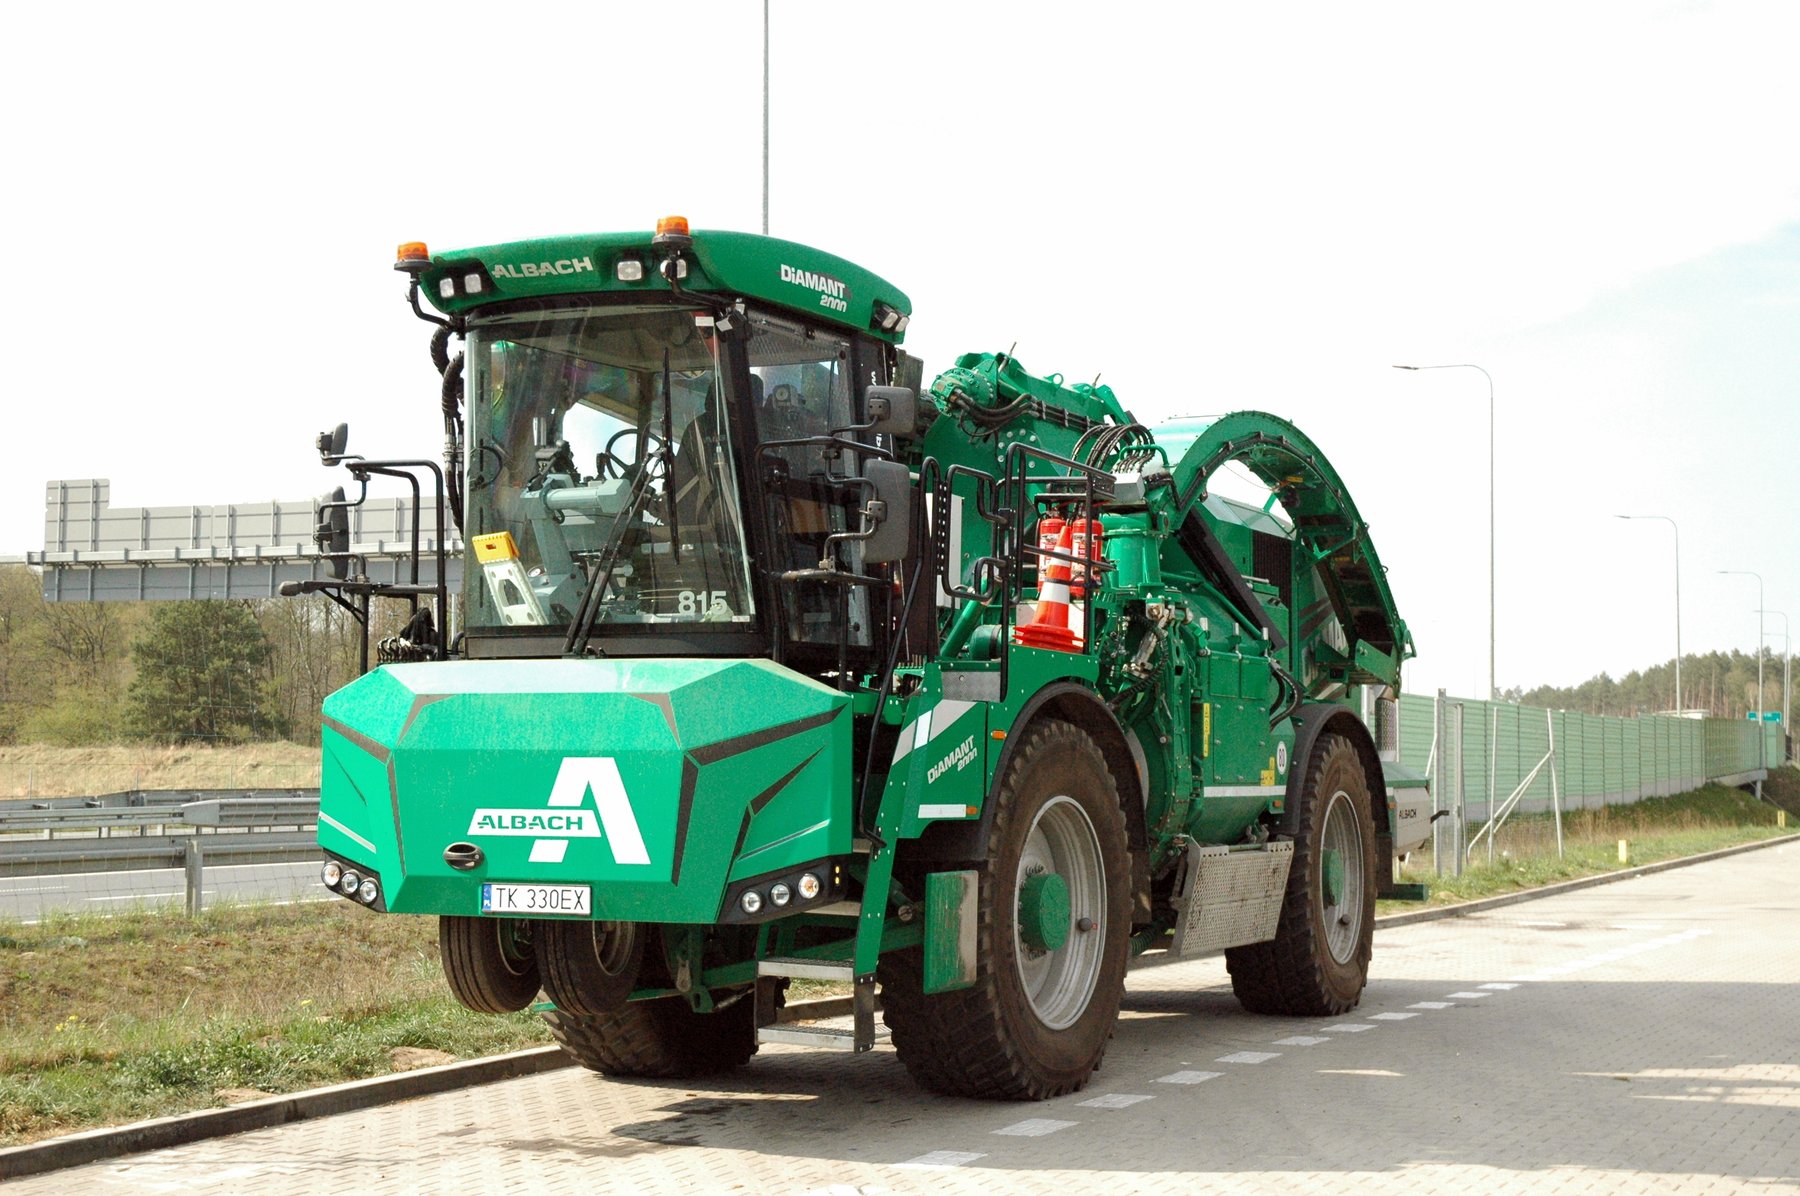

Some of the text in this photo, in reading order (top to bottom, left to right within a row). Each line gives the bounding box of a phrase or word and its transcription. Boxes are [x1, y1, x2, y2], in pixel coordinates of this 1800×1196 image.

[491, 256, 593, 278] ALBACH
[820, 294, 848, 313] 2000
[678, 590, 728, 615] 815
[957, 747, 978, 772] 2000
[477, 814, 583, 831] ALBACH
[1398, 808, 1417, 820] ALBACH
[496, 887, 518, 909] TK
[526, 888, 585, 911] 330EX
